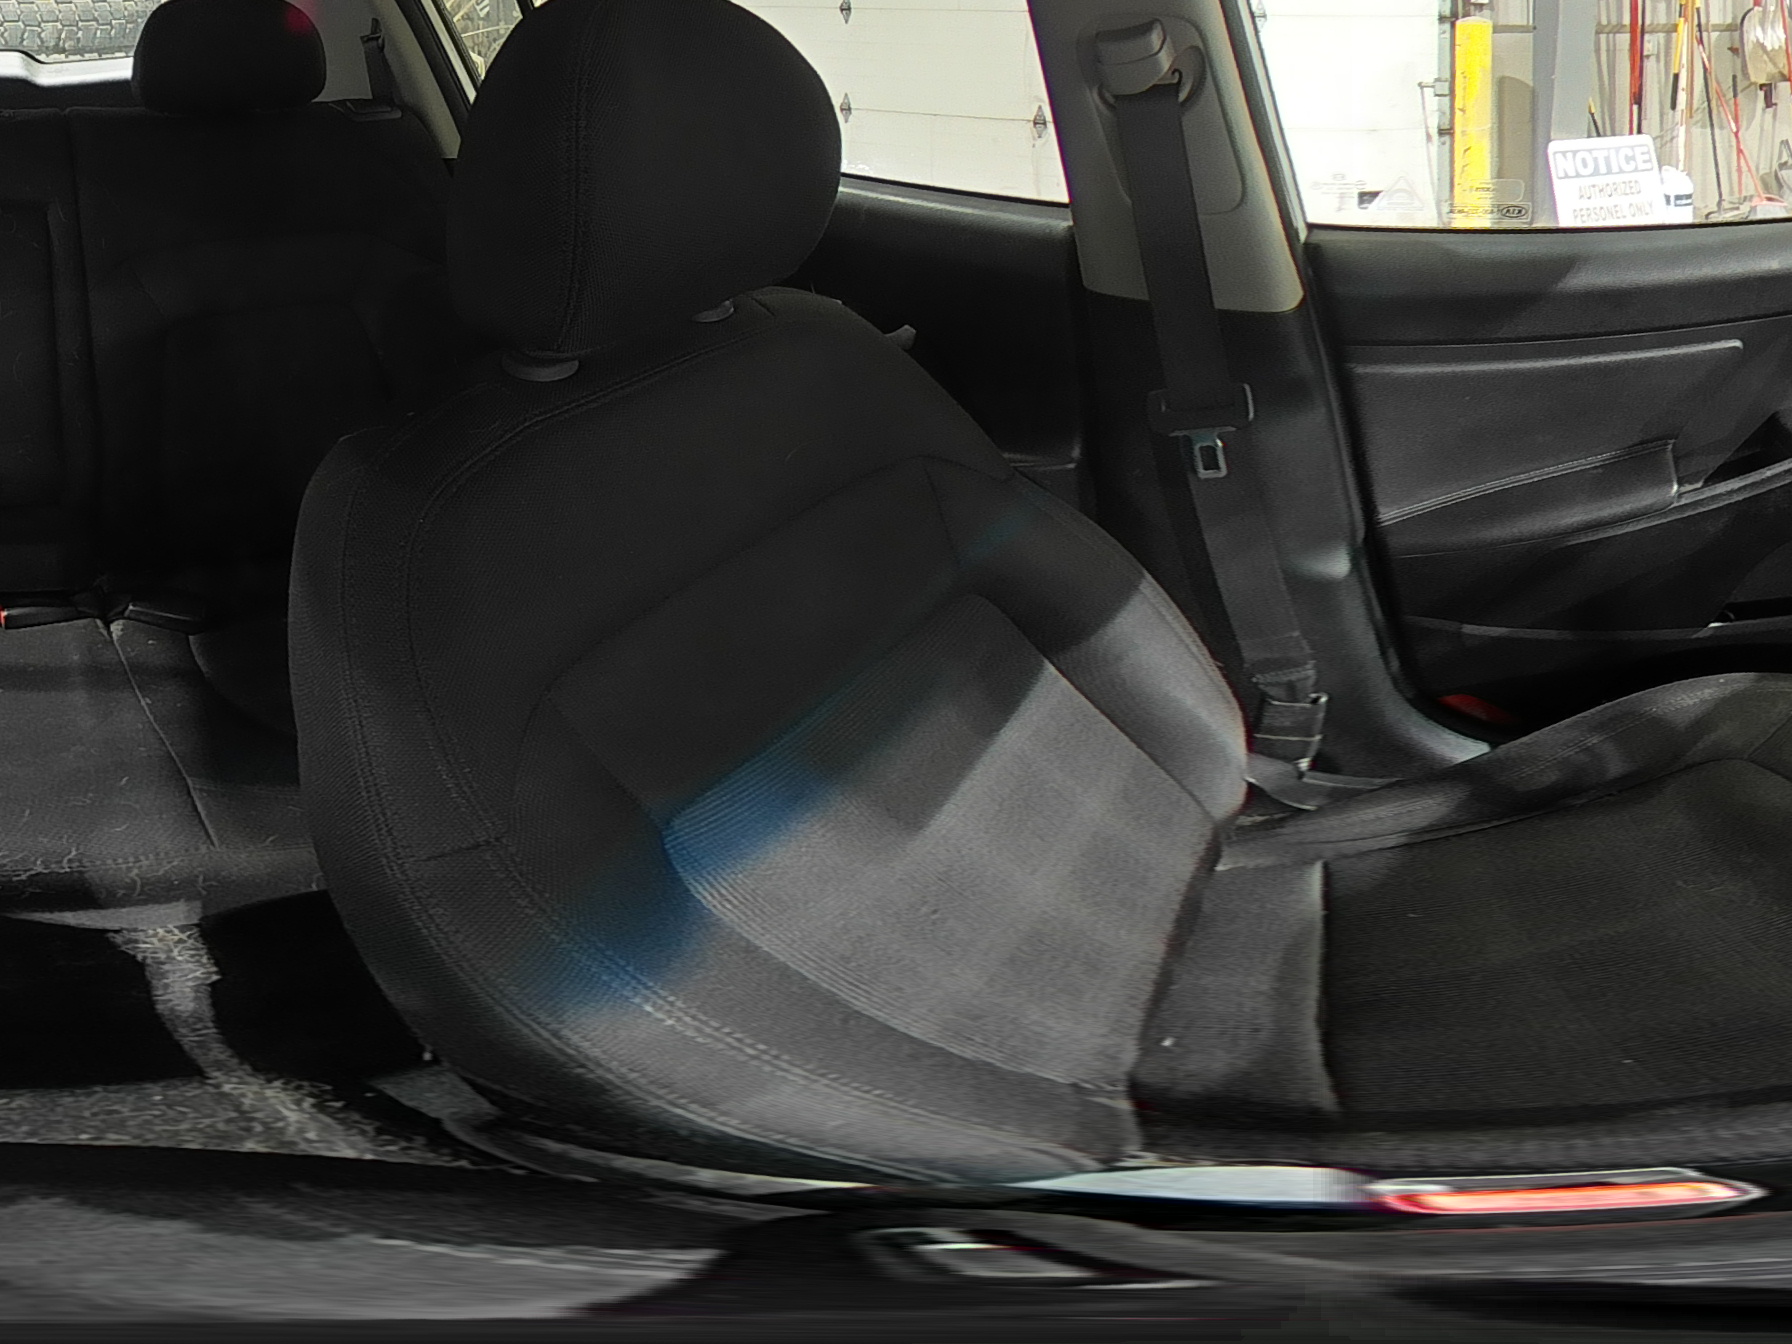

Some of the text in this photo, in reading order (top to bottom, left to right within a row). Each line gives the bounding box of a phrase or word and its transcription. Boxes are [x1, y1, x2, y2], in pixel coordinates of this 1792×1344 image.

[1554, 145, 1653, 179] NOTICE
[1578, 180, 1642, 201] AUTHORIZED
[1572, 201, 1655, 224] PERSONEL ONLY
